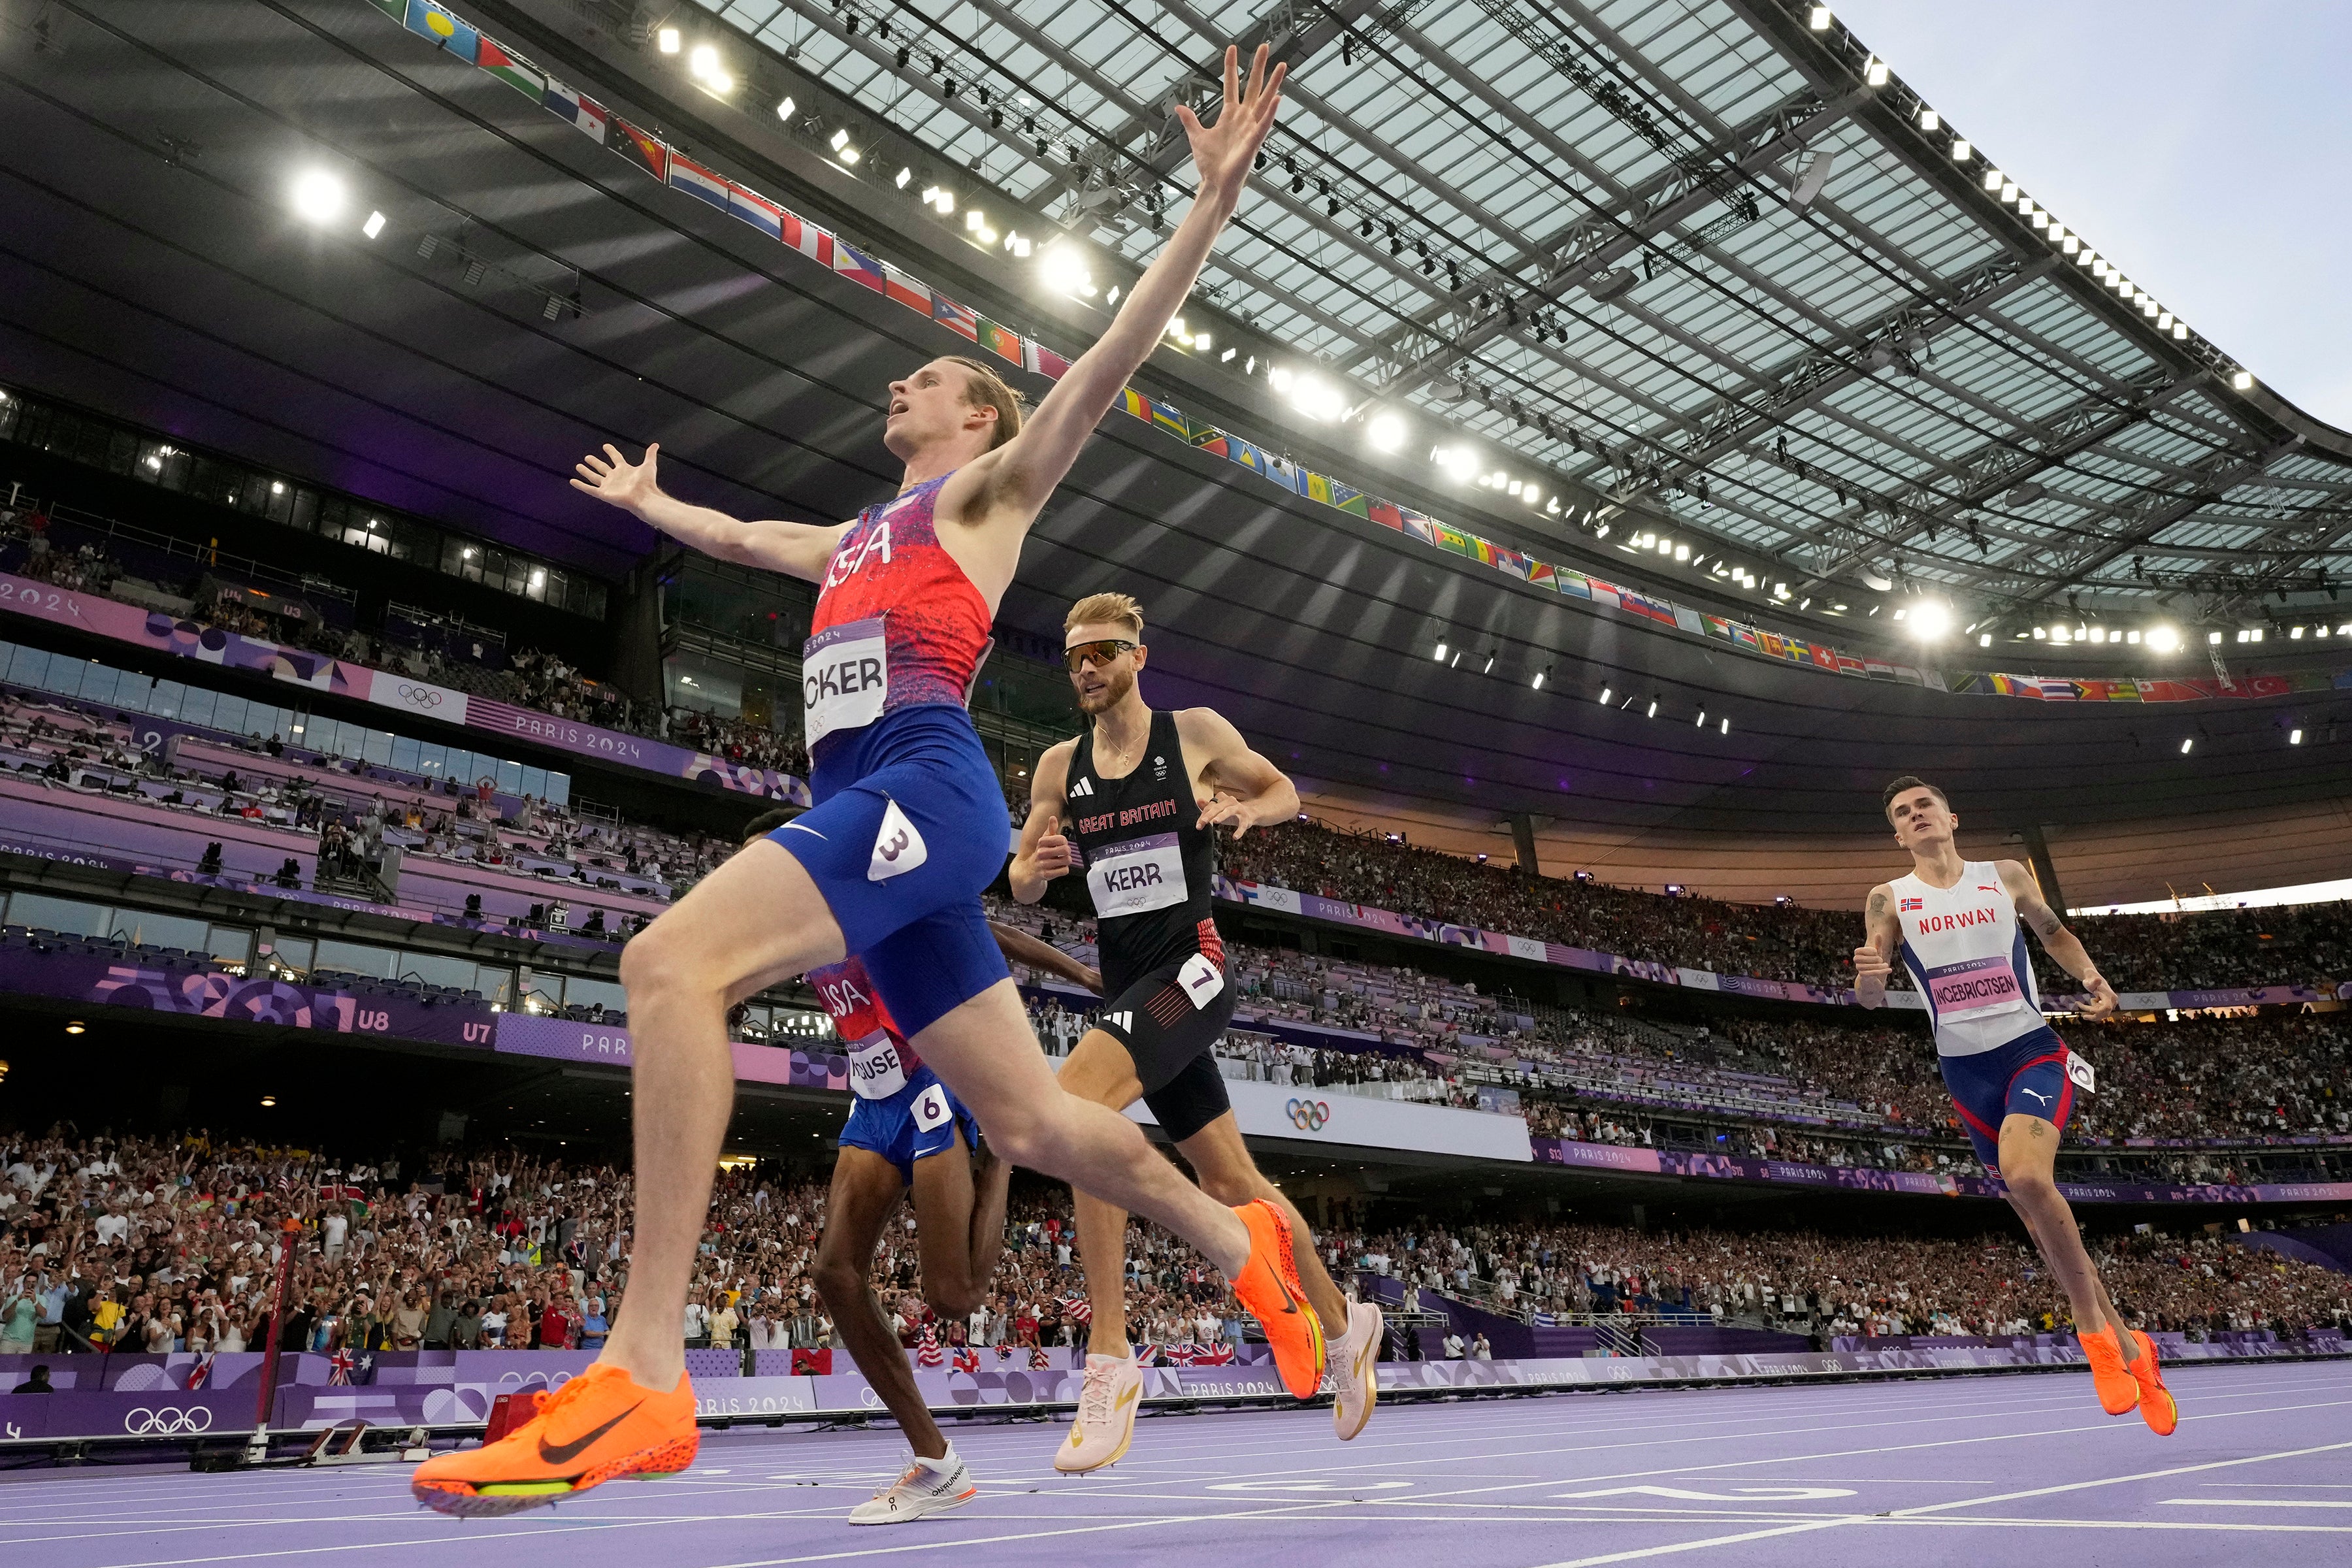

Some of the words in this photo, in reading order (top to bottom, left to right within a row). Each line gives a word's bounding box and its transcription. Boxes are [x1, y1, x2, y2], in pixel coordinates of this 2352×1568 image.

[283, 604, 301, 618] U3
[813, 631, 840, 649] 2024
[805, 657, 883, 710] CKER
[141, 731, 163, 757] 2
[515, 715, 578, 743] PARIS
[587, 734, 640, 759] 2024
[1079, 812, 1115, 834] GREAT
[1120, 798, 1177, 826] BRITAIN
[878, 828, 909, 862] 3
[1105, 845, 1127, 855] PARIS
[1129, 840, 1151, 851] 2024
[1104, 862, 1163, 893] KERR
[1319, 902, 1352, 919] PARIS
[1356, 911, 1385, 925] 024
[1919, 908, 1995, 935] NORWAY
[1943, 964, 1965, 974] PARIS
[1967, 961, 1986, 970] 2024
[1192, 966, 1214, 990] 7
[1740, 981, 1761, 992] ARIS
[1763, 984, 1782, 994] 202
[1933, 975, 2016, 1006] INGEBRIGTSEN
[817, 979, 870, 1017] USA
[2193, 992, 2229, 1002] PARIS
[2232, 992, 2249, 1002] 20
[359, 1010, 389, 1031] U8
[463, 1022, 491, 1043] U7
[583, 1034, 626, 1056] PAR
[924, 1096, 940, 1120] 6
[1549, 1148, 1563, 1160] S13
[1574, 1148, 1604, 1161] PARIS
[1605, 1151, 1631, 1164] 2024
[1732, 1166, 1744, 1177] S12
[1780, 1167, 1805, 1177] PARIS
[1806, 1169, 1827, 1180] 2024
[1905, 1177, 1926, 1187] PARIS
[1929, 1179, 1939, 1188] 20
[2068, 1188, 2092, 1197] PARIS
[2094, 1188, 2115, 1198] 2024
[2280, 1188, 2310, 1197] PARIS
[2313, 1188, 2340, 1196] 2024
[272, 1267, 284, 1320] OMEGA
[1527, 1373, 1558, 1383] PARIS
[1560, 1372, 1586, 1383] 2024
[1764, 1365, 1788, 1375] PARIS
[1788, 1364, 1808, 1374] 2024
[1191, 1382, 1233, 1396] PARIS
[1237, 1381, 1274, 1395] 2024
[695, 1397, 740, 1414] ARIS
[749, 1396, 804, 1413] 2024
[932, 1486, 944, 1497] ON
